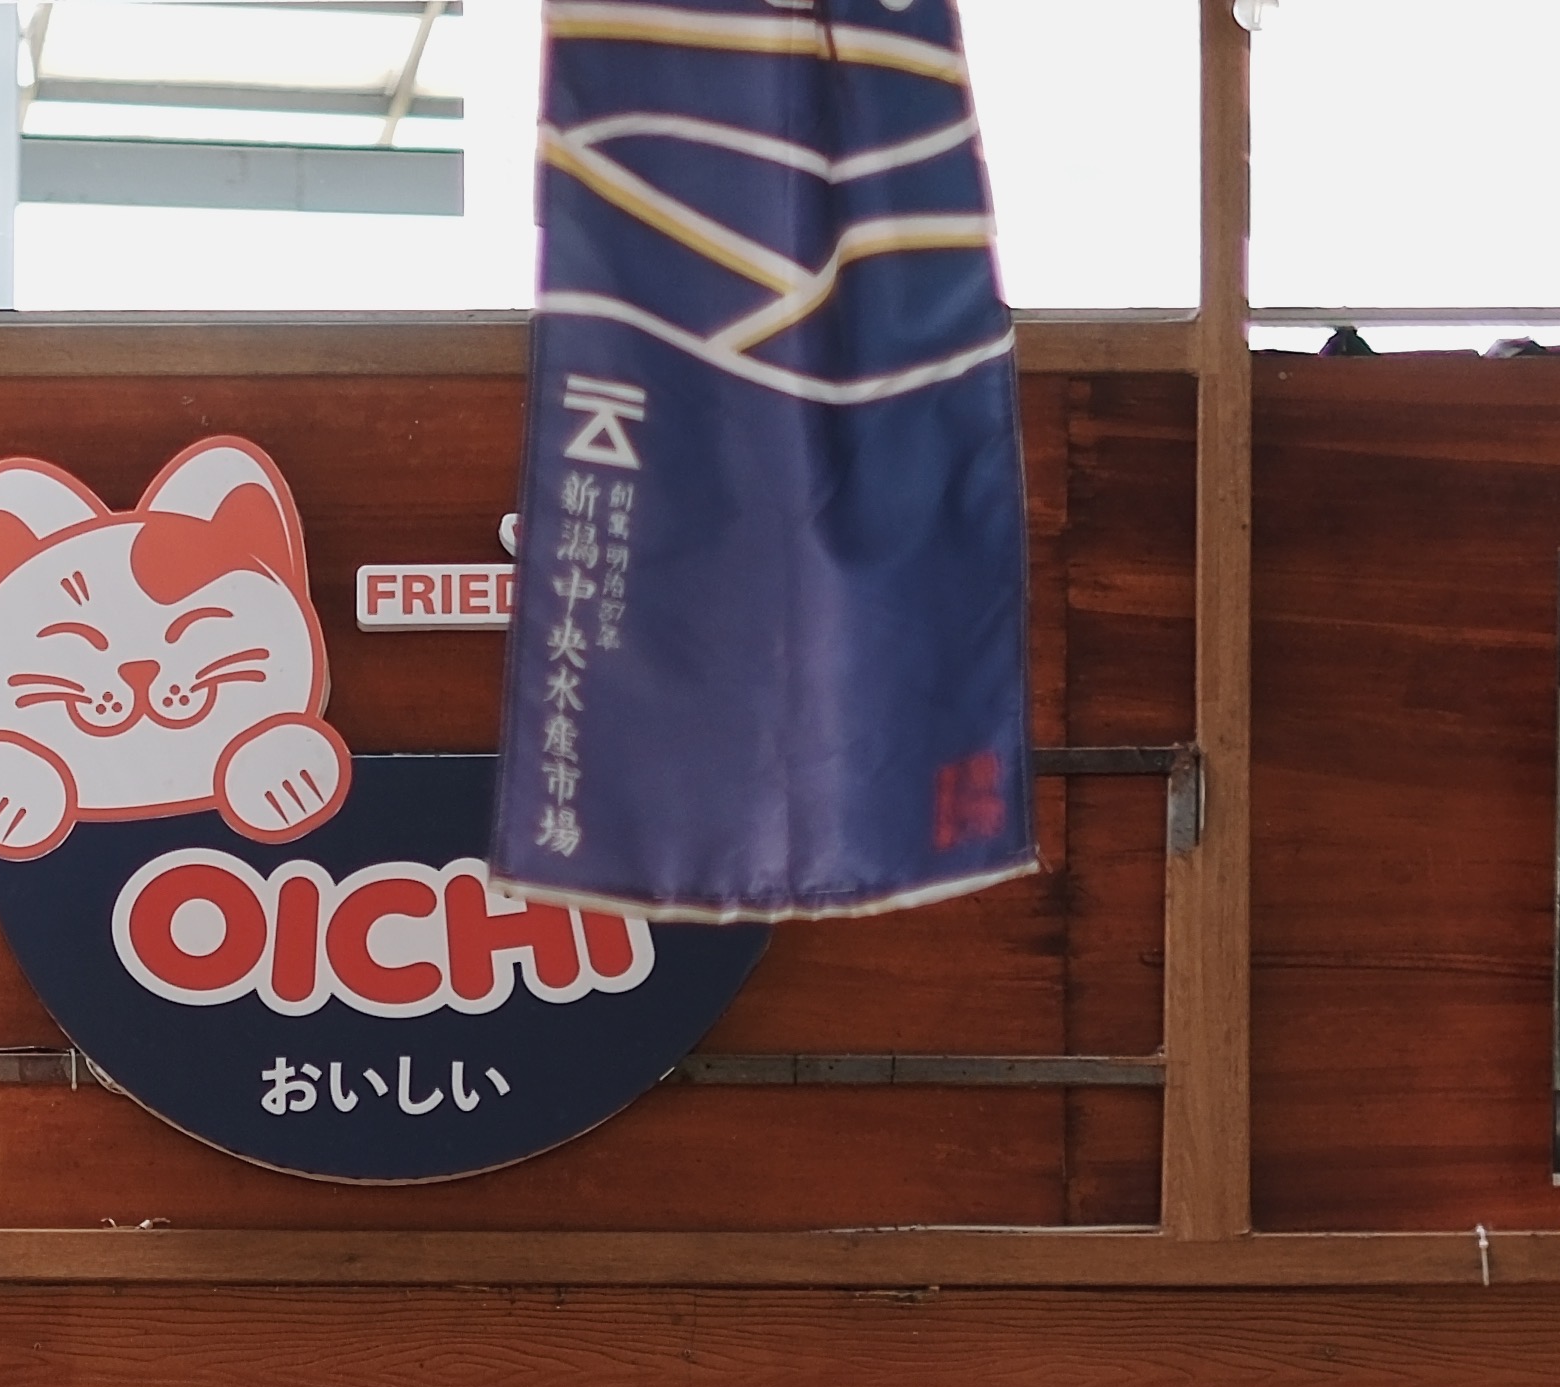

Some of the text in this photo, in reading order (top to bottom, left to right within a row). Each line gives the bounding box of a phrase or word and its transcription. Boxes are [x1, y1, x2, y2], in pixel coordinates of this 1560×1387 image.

[536, 472, 602, 858] 新潟中央水産市場
[128, 862, 634, 1006] OICHI
[260, 1054, 511, 1116] おいしい
